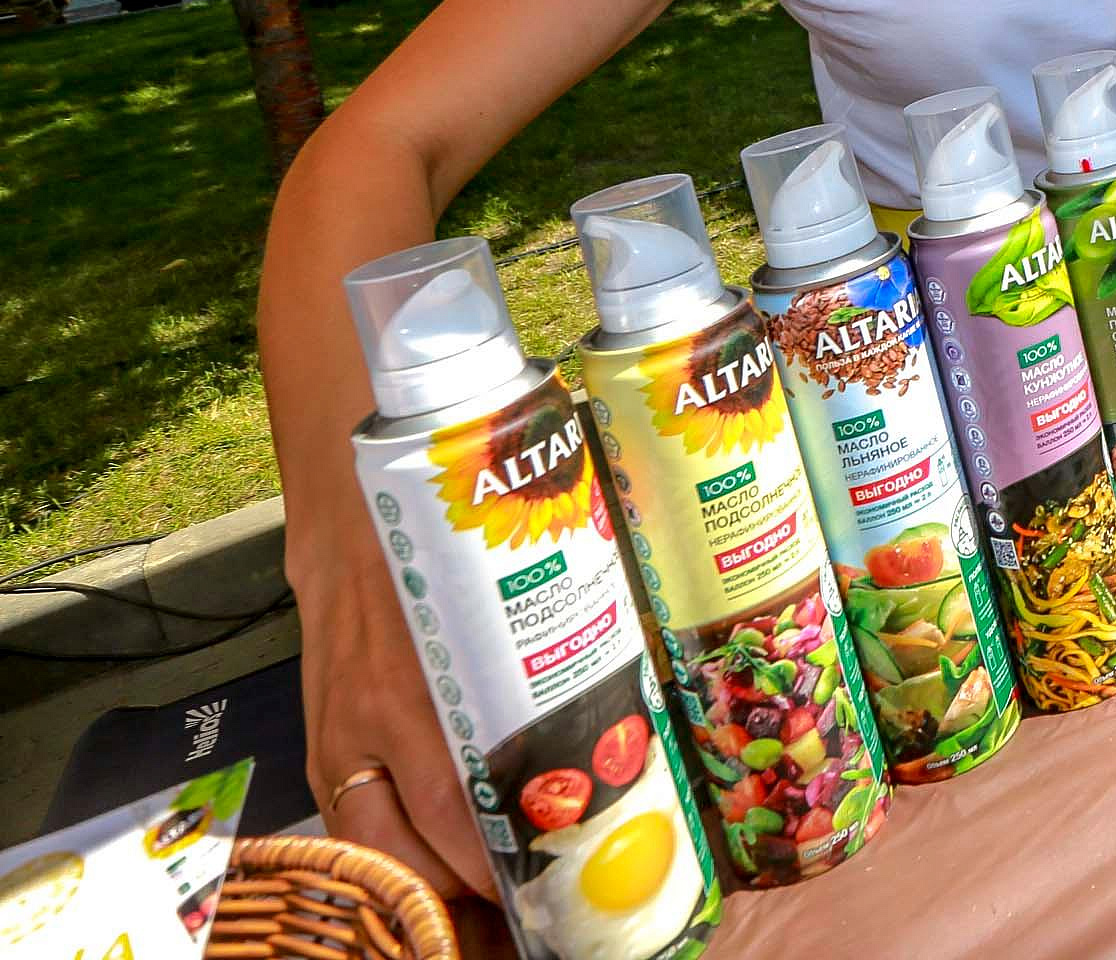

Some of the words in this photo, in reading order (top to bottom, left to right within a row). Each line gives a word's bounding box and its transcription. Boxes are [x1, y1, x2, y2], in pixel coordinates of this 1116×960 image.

[815, 355, 852, 372] ПОЛЬЗА
[853, 353, 861, 363] В
[861, 337, 899, 360] КАЖДОЙ
[1022, 339, 1057, 363] 100%
[1021, 353, 1065, 383] МАСЛО
[1023, 351, 1085, 396] КУНЖУТНОЕ
[1036, 389, 1087, 427] ВЫГОДНО
[837, 415, 880, 436] 100%
[1063, 425, 1076, 438] 250
[837, 431, 889, 455] МАСЛО
[841, 437, 909, 469] ЛЬНЯНОЕ
[845, 436, 939, 482] НЕРАФИНИРОВАННОЕ
[703, 467, 752, 498] 100%
[855, 467, 923, 501] ВЫГОДНО
[909, 482, 934, 497] РАСХОД
[700, 484, 760, 520] МАСЛО
[857, 510, 887, 525] БАЛЛОН
[886, 506, 902, 518] 250
[720, 523, 792, 569] ВЫГОДНО
[506, 555, 563, 593] 100%
[724, 576, 756, 594] БАЛЛОН
[756, 569, 772, 582] 250
[504, 575, 574, 619] МАСЛО
[530, 610, 613, 672] ВЫГОДНО
[572, 666, 590, 686] 250
[184, 712, 221, 762] Helios
[950, 750, 967, 764] 250
[831, 827, 848, 847] 250
